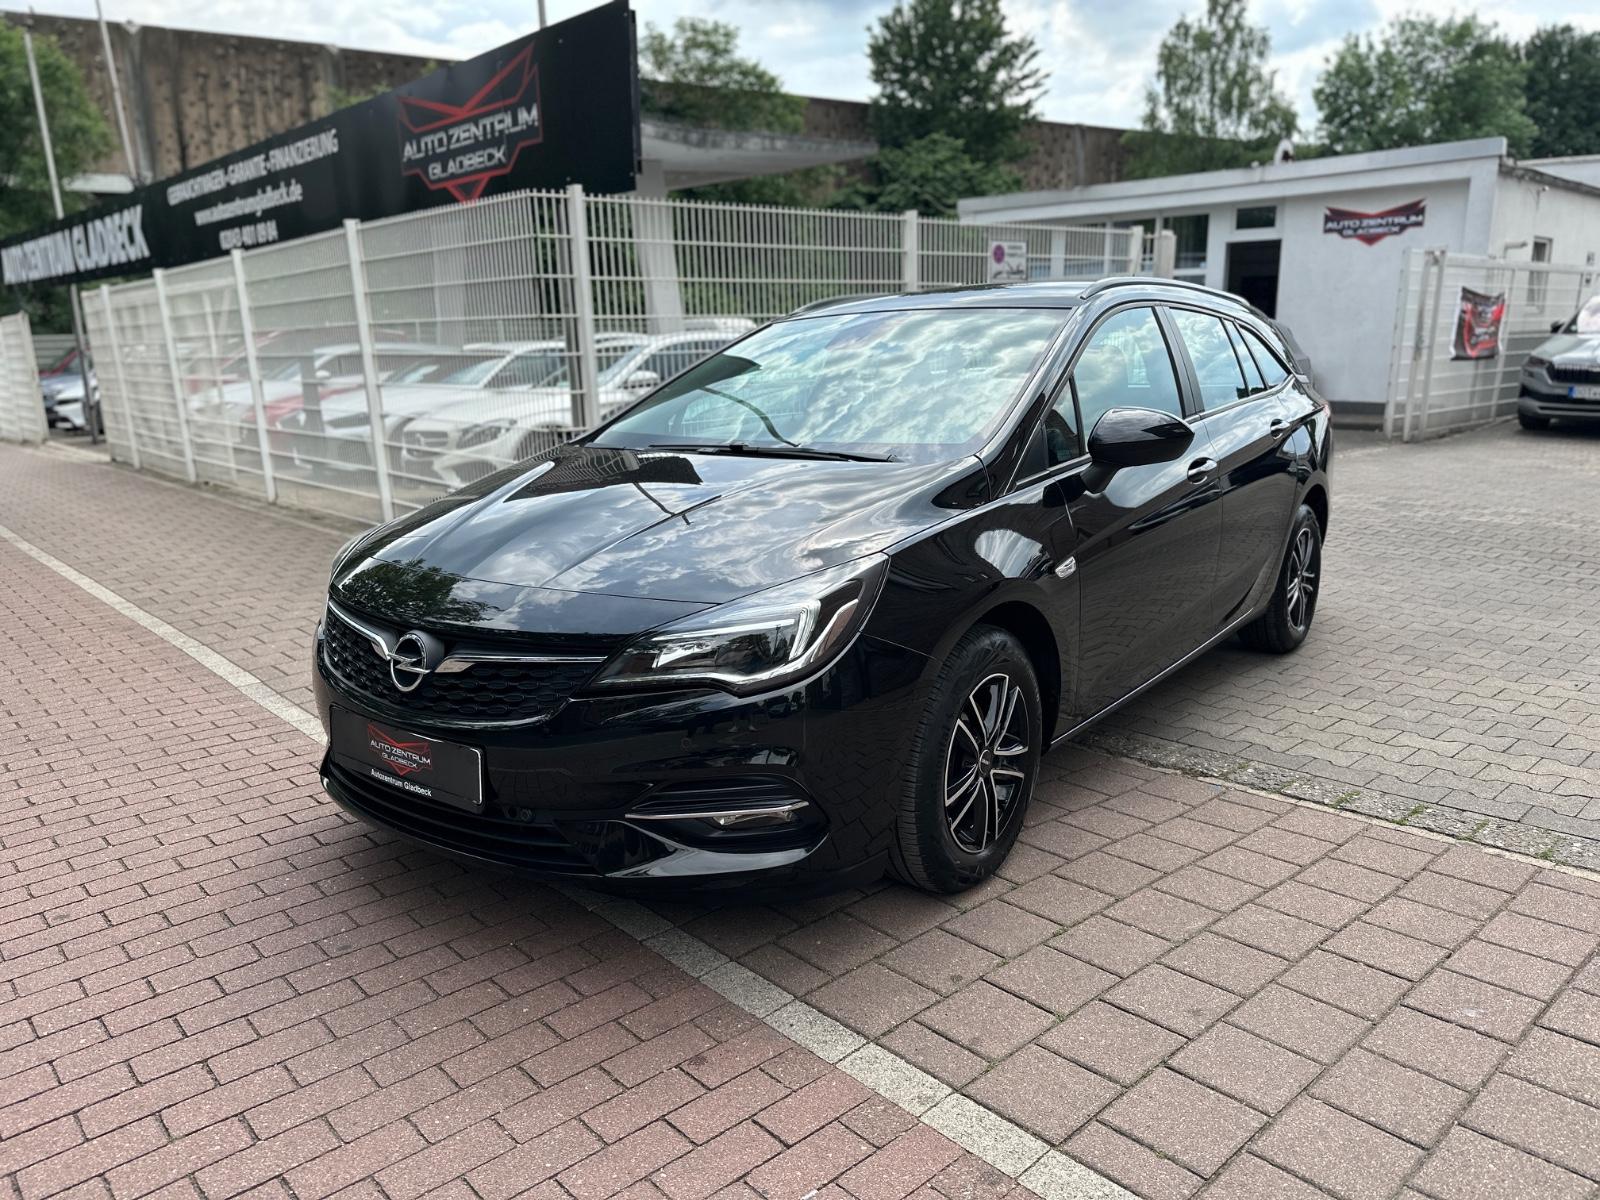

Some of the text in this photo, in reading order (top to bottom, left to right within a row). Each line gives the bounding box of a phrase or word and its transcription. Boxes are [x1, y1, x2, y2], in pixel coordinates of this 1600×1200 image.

[402, 103, 539, 162] AUTO ZENTRUM
[428, 145, 507, 180] GLADBECK
[1326, 214, 1424, 230] AUTO ZENTRUM
[71, 204, 150, 272] GLADBECK
[370, 739, 431, 766] AUTO ZENTRUM
[381, 752, 418, 769] GLADBECK
[370, 768, 432, 797] Autozentrum Gladbeck
